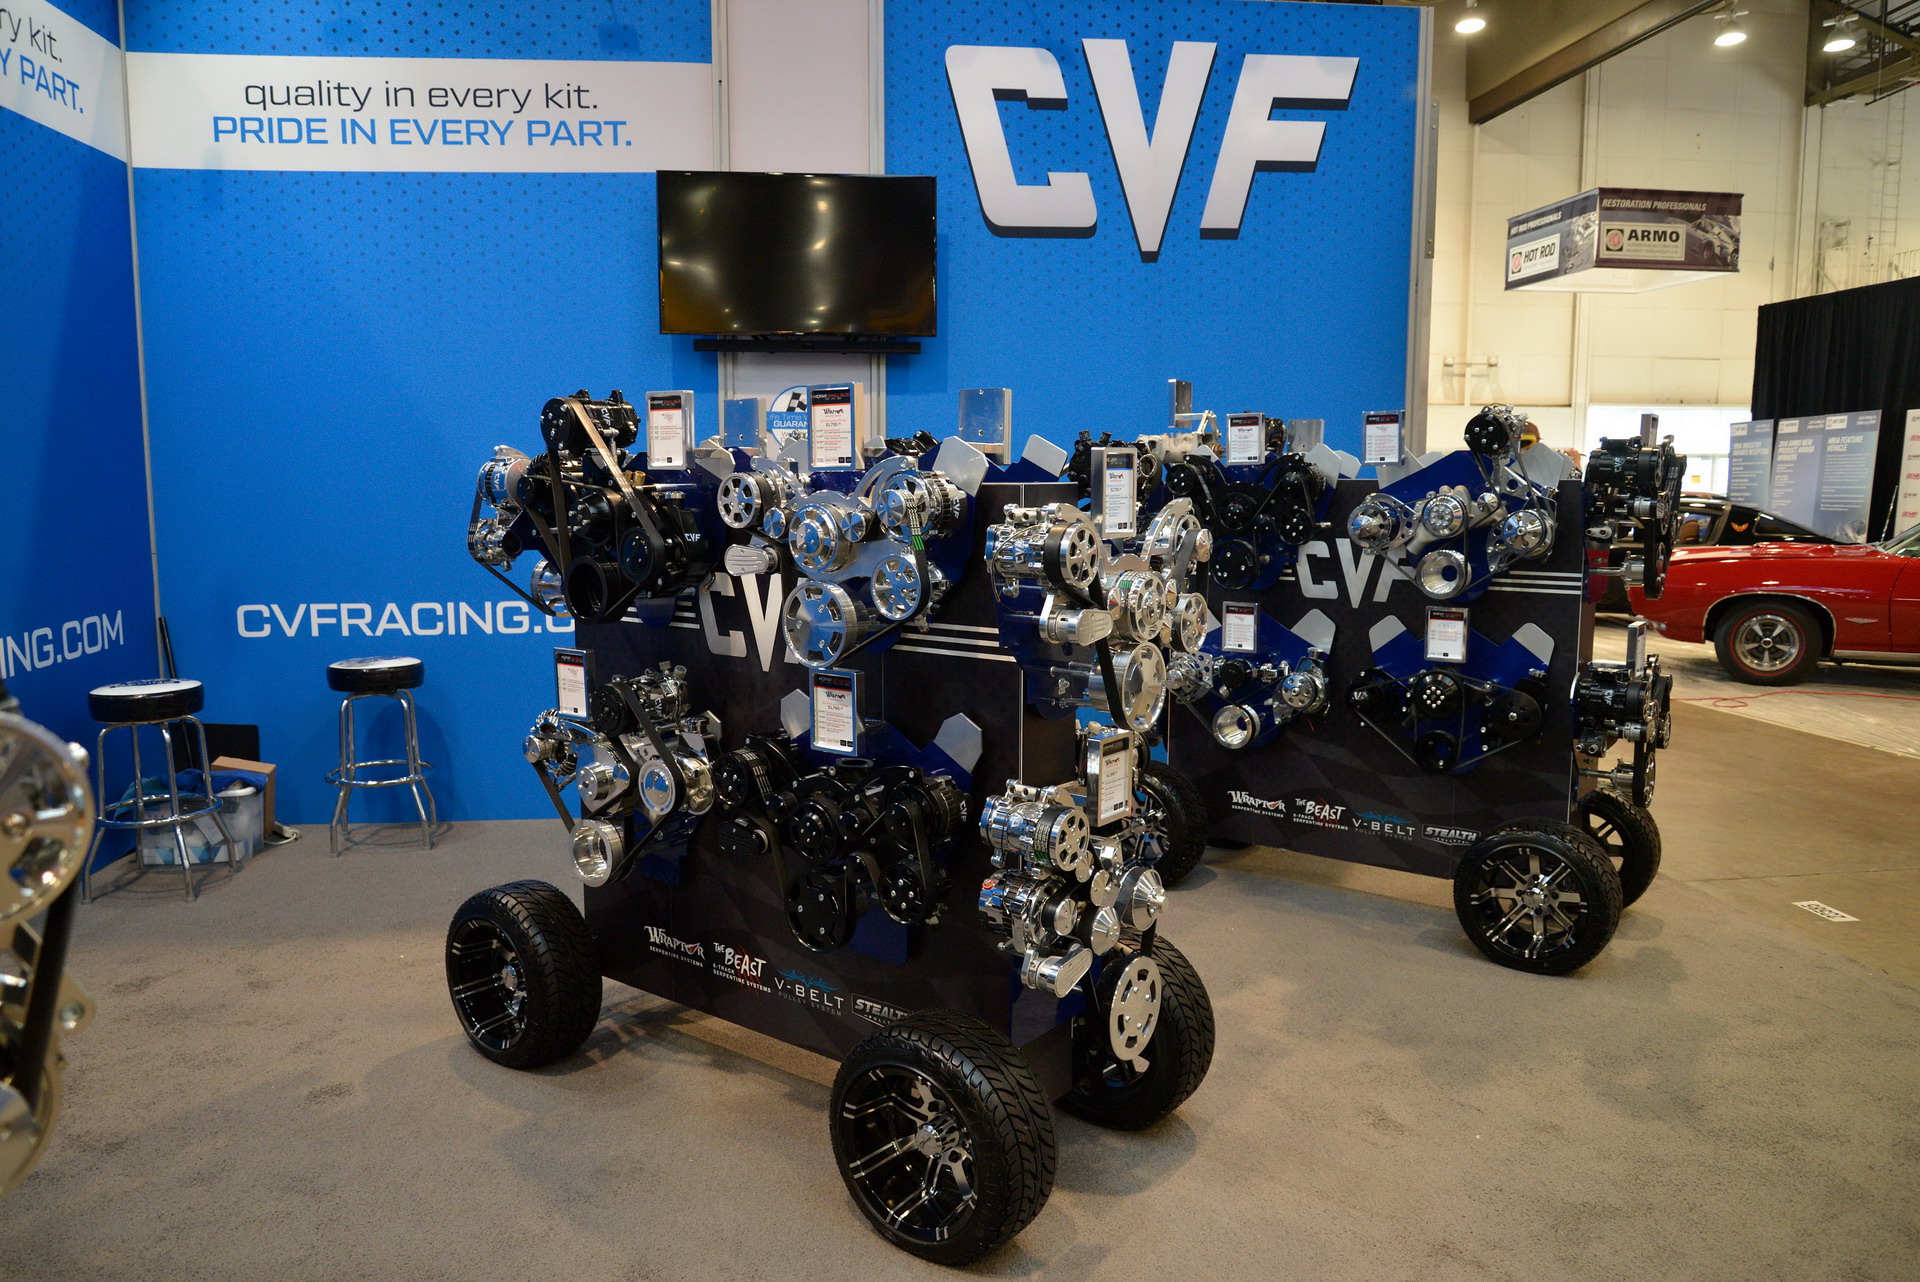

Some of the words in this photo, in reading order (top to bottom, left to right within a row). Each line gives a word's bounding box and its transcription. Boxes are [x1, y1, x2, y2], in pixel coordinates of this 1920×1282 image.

[29, 17, 62, 62] kit.
[20, 54, 83, 114] PART.
[244, 80, 372, 110] quality
[385, 81, 415, 107] in
[428, 87, 528, 111] every
[544, 82, 598, 109] kit.
[212, 116, 328, 145] PRIDE
[340, 117, 377, 145] IN
[390, 119, 513, 146] EVERY
[526, 120, 632, 147] PART.
[945, 38, 1360, 262] CVF
[1602, 199, 1652, 209] RESTORATION
[1653, 201, 1707, 211] PROFESSIONALS
[1627, 229, 1680, 243] ARMO
[1523, 247, 1539, 263] HOT
[1540, 242, 1556, 260] ROD
[684, 533, 701, 543] CVF
[1295, 798, 1306, 806] THE
[1352, 818, 1415, 836] V-BELT
[1424, 827, 1477, 841] STEALTH
[713, 942, 725, 953] THE
[712, 969, 745, 985] SERPENTINE
[746, 980, 772, 993] SYSTEMS
[774, 977, 844, 1009] V-BELT
[778, 991, 807, 1005] PULLEY
[810, 1002, 842, 1016] SYSTEM
[855, 998, 908, 1021] STEALT
